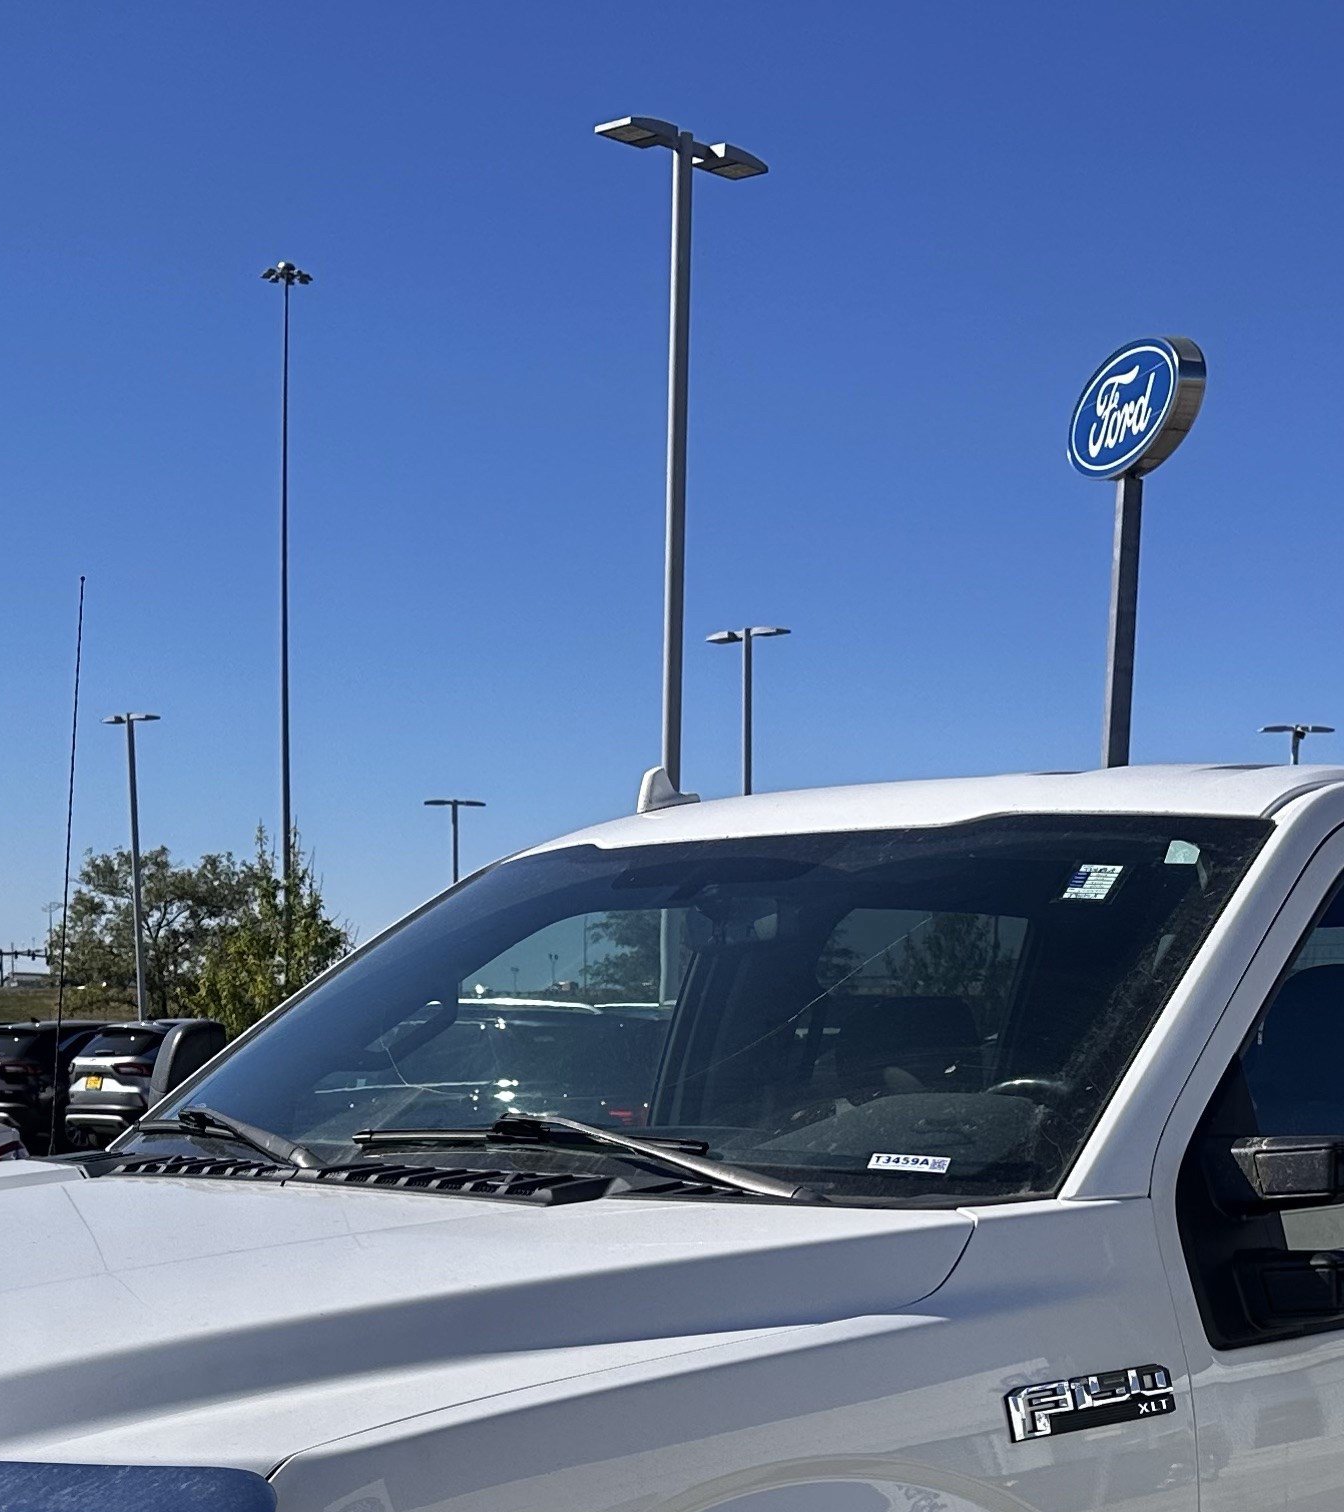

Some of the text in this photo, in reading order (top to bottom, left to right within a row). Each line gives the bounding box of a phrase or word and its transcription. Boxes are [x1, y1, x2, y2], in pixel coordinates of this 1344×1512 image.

[1088, 365, 1155, 458] Ford
[874, 1155, 930, 1166] T3459A
[1137, 1399, 1169, 1415] XLT
